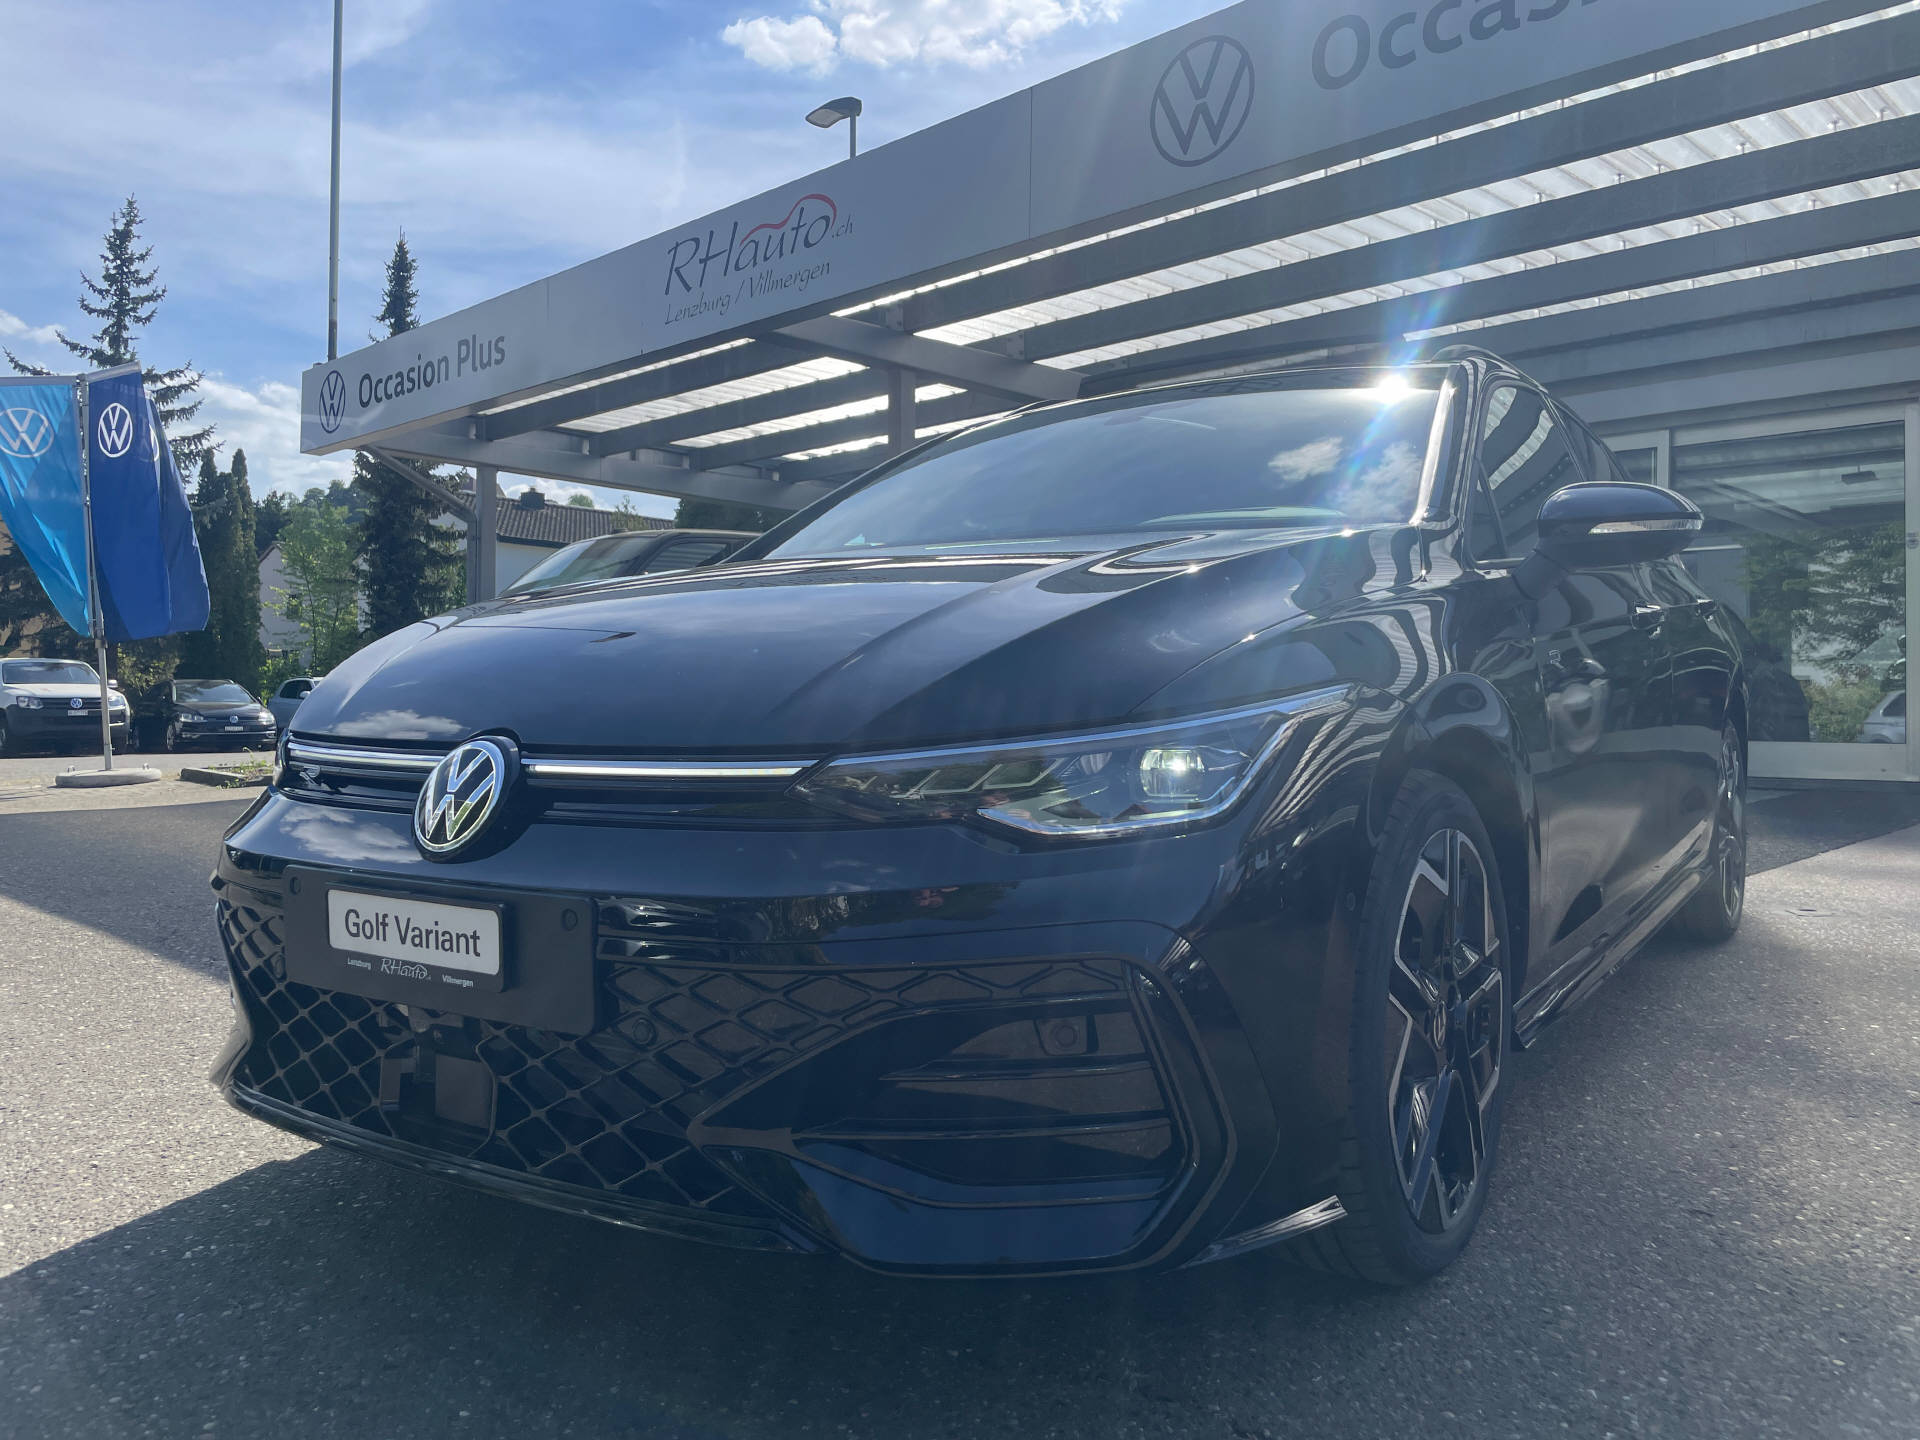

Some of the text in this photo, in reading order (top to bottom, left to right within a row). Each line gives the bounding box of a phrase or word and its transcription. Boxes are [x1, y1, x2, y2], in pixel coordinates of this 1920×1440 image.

[358, 334, 506, 408] Occasion Plus
[344, 908, 481, 957] Golf Variant
